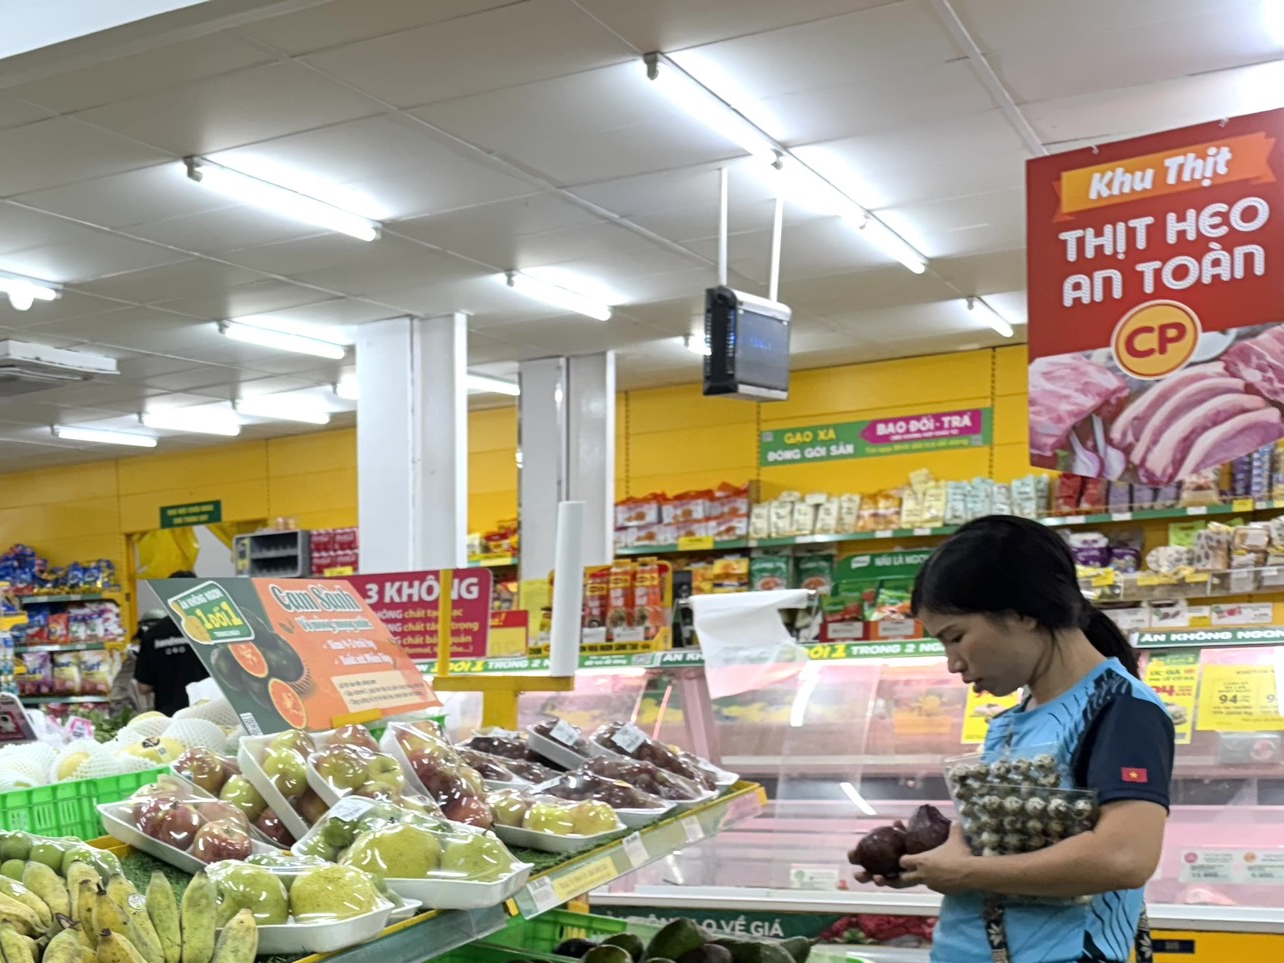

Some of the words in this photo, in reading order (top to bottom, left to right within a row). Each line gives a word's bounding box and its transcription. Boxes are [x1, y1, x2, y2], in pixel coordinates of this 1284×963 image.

[1089, 167, 1155, 200] Khu
[1164, 147, 1232, 187] Thịt
[1058, 216, 1155, 262] THỊT
[1166, 197, 1270, 244] HEO
[1062, 269, 1123, 307] AN
[1134, 241, 1265, 294] TOÀN
[1125, 322, 1187, 358] CP
[876, 421, 907, 436] BAO
[268, 583, 321, 612] Cam
[308, 584, 363, 612] Sành
[366, 583, 379, 604] 3
[1170, 629, 1233, 642] KHÔNG
[850, 644, 902, 655] TRONG
[904, 643, 916, 653] 2
[488, 659, 528, 670] TRONG
[531, 659, 541, 668] 2
[750, 918, 784, 937] GIÁ
